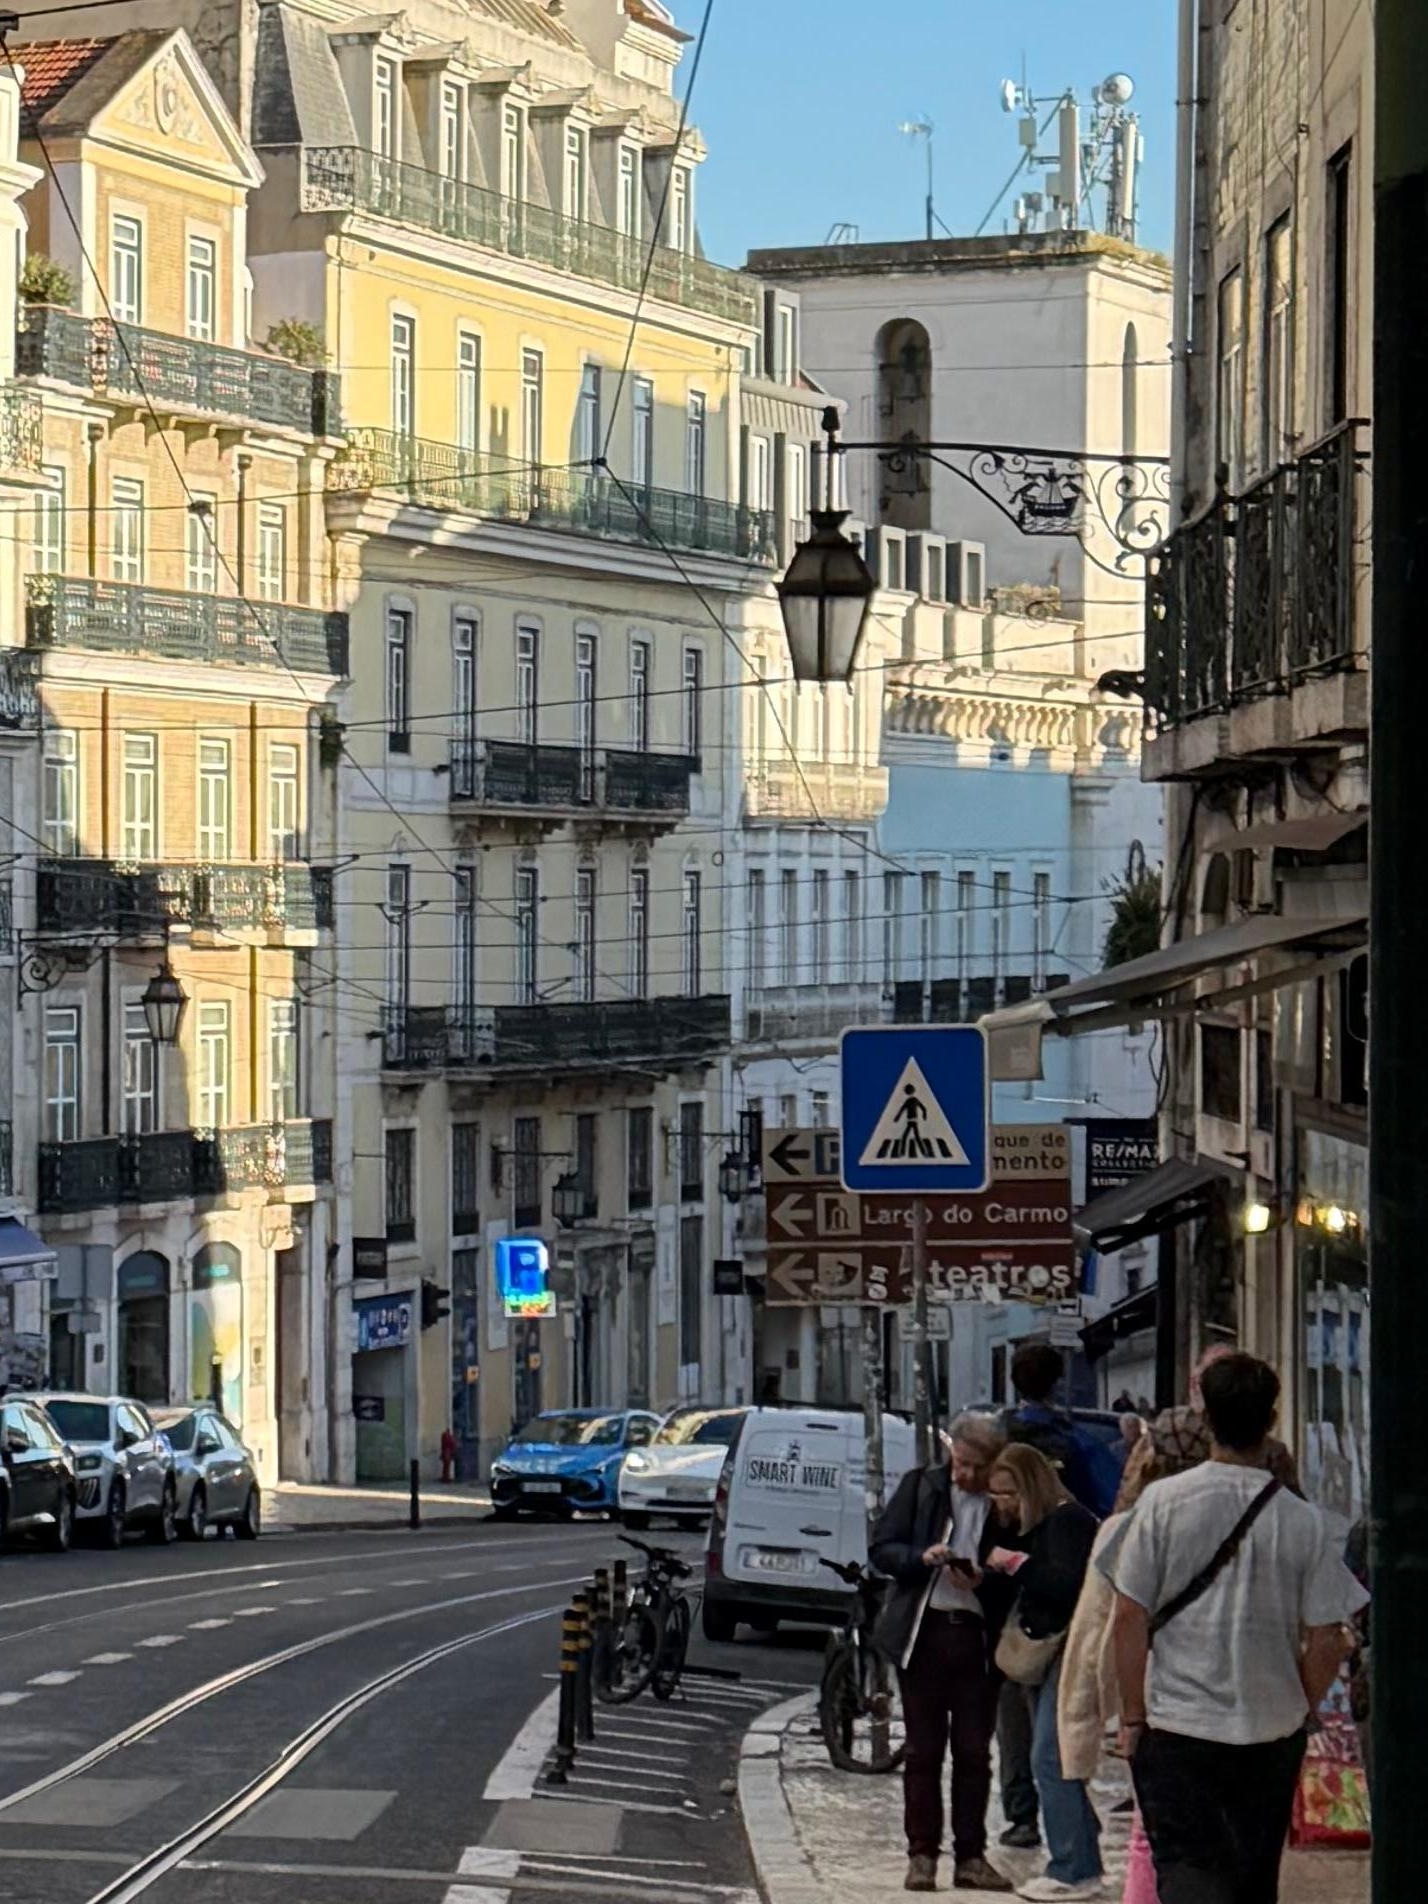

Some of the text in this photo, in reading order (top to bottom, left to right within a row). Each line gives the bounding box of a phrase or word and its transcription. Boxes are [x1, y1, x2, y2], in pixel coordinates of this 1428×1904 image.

[1041, 1132, 1066, 1148] de
[942, 1204, 974, 1225] do
[984, 1202, 1069, 1224] Carmo
[748, 1459, 796, 1485] SMART
[802, 1466, 840, 1489] WINE
